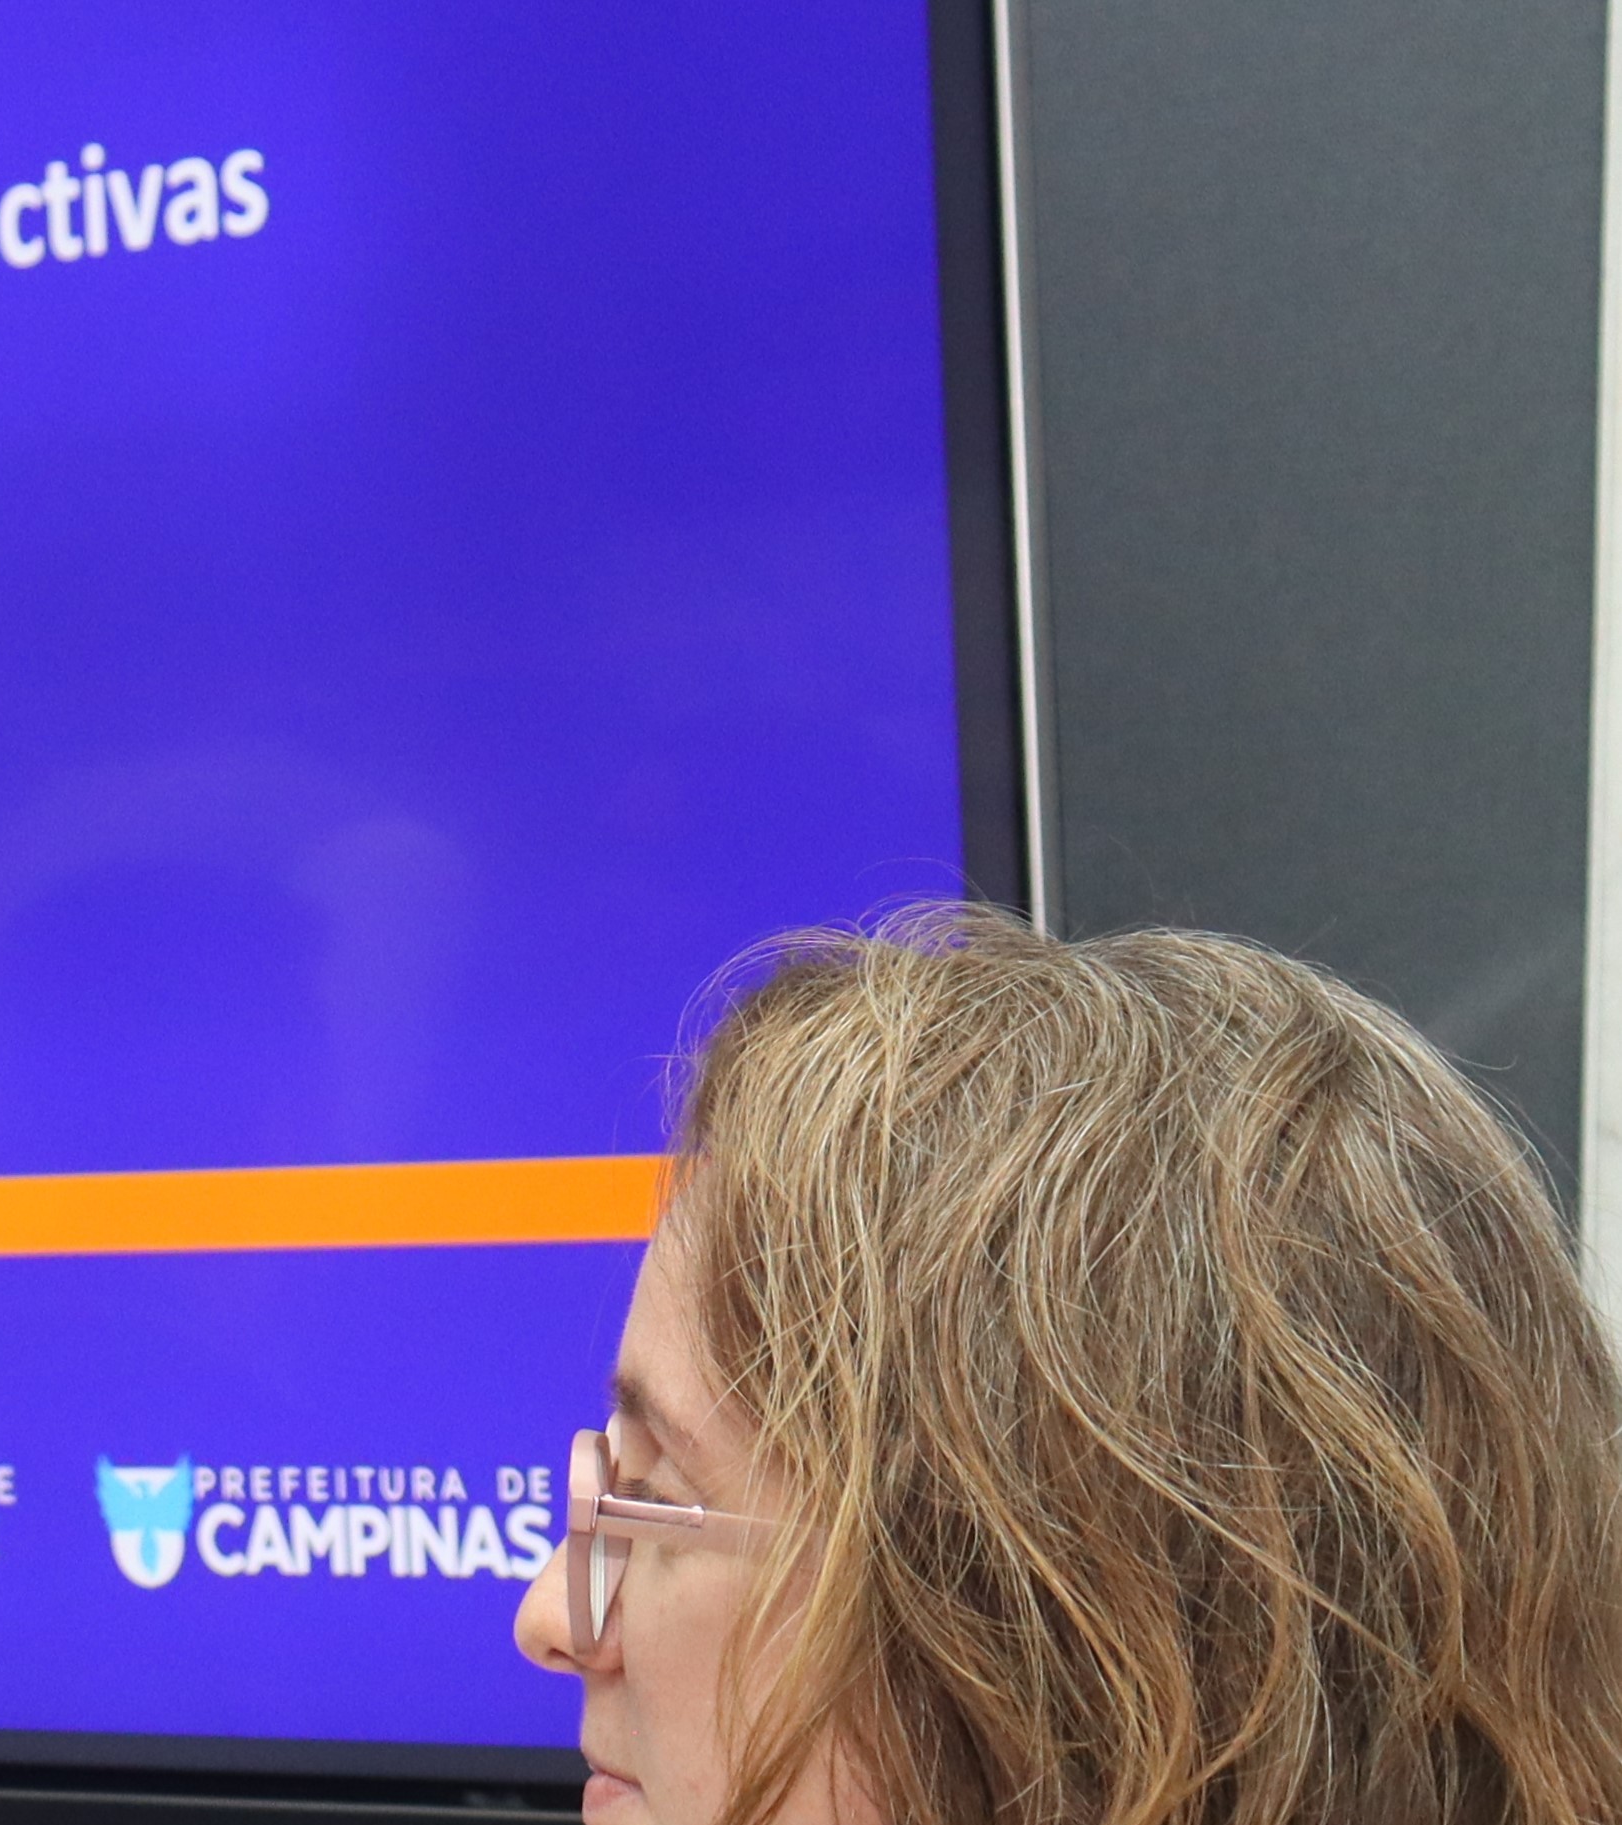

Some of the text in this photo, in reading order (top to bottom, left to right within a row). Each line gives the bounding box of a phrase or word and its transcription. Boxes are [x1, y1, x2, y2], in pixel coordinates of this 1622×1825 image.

[194, 1465, 553, 1503] PREFEITURA DE
[195, 1504, 554, 1580] CAMPINAS
